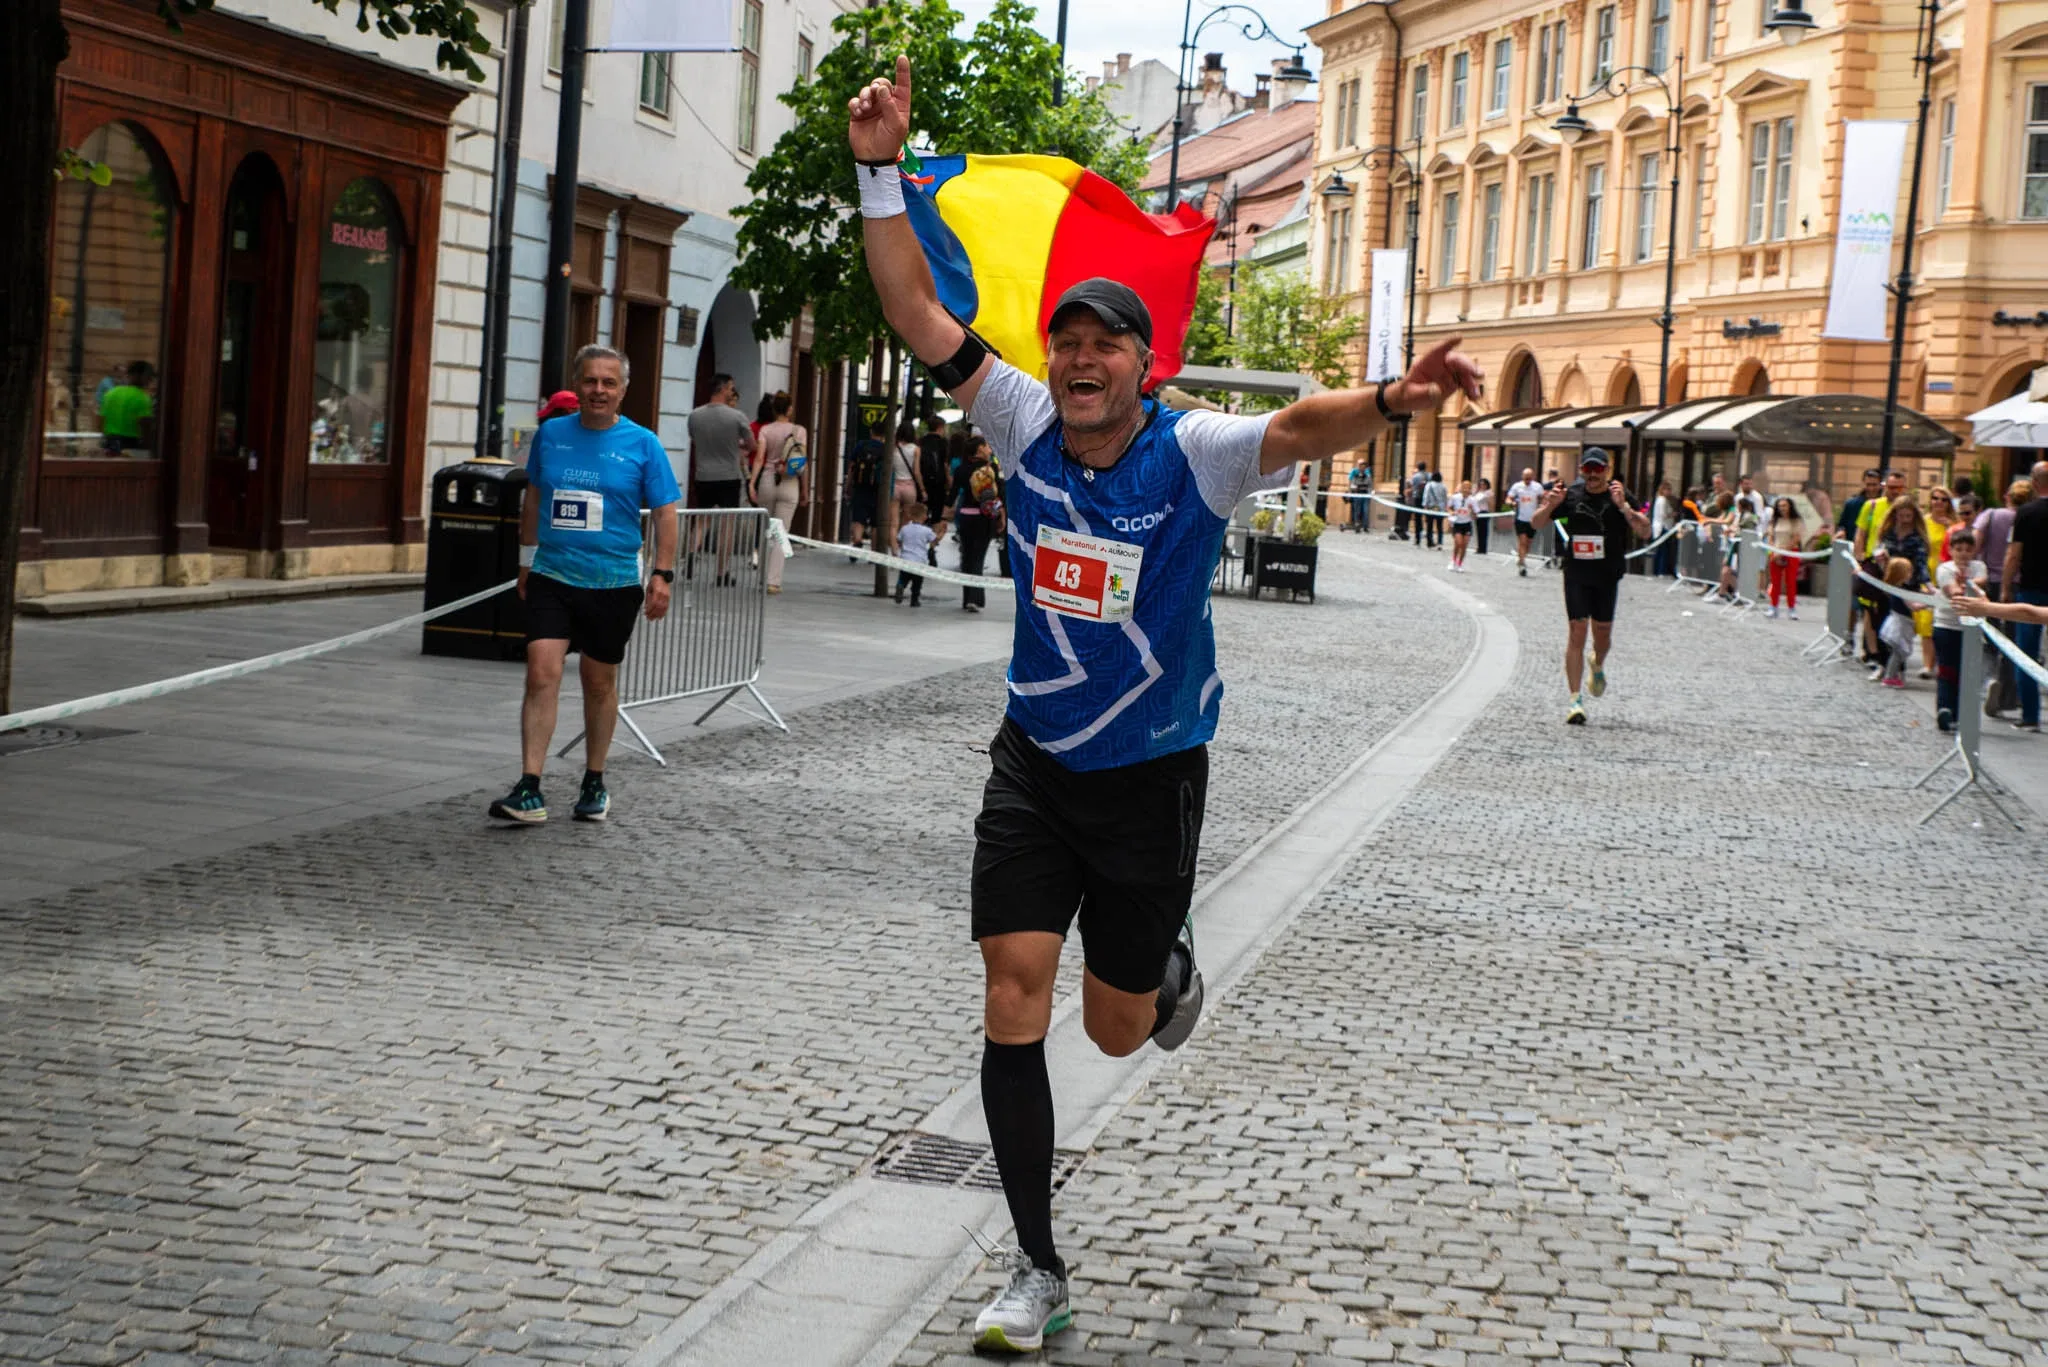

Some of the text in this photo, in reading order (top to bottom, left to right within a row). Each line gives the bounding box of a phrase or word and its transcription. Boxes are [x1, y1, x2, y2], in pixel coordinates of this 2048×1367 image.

[564, 468, 600, 479] CLUBUL
[560, 504, 578, 517] 819
[1061, 537, 1097, 551] Maratonul
[1054, 560, 1081, 590] 43
